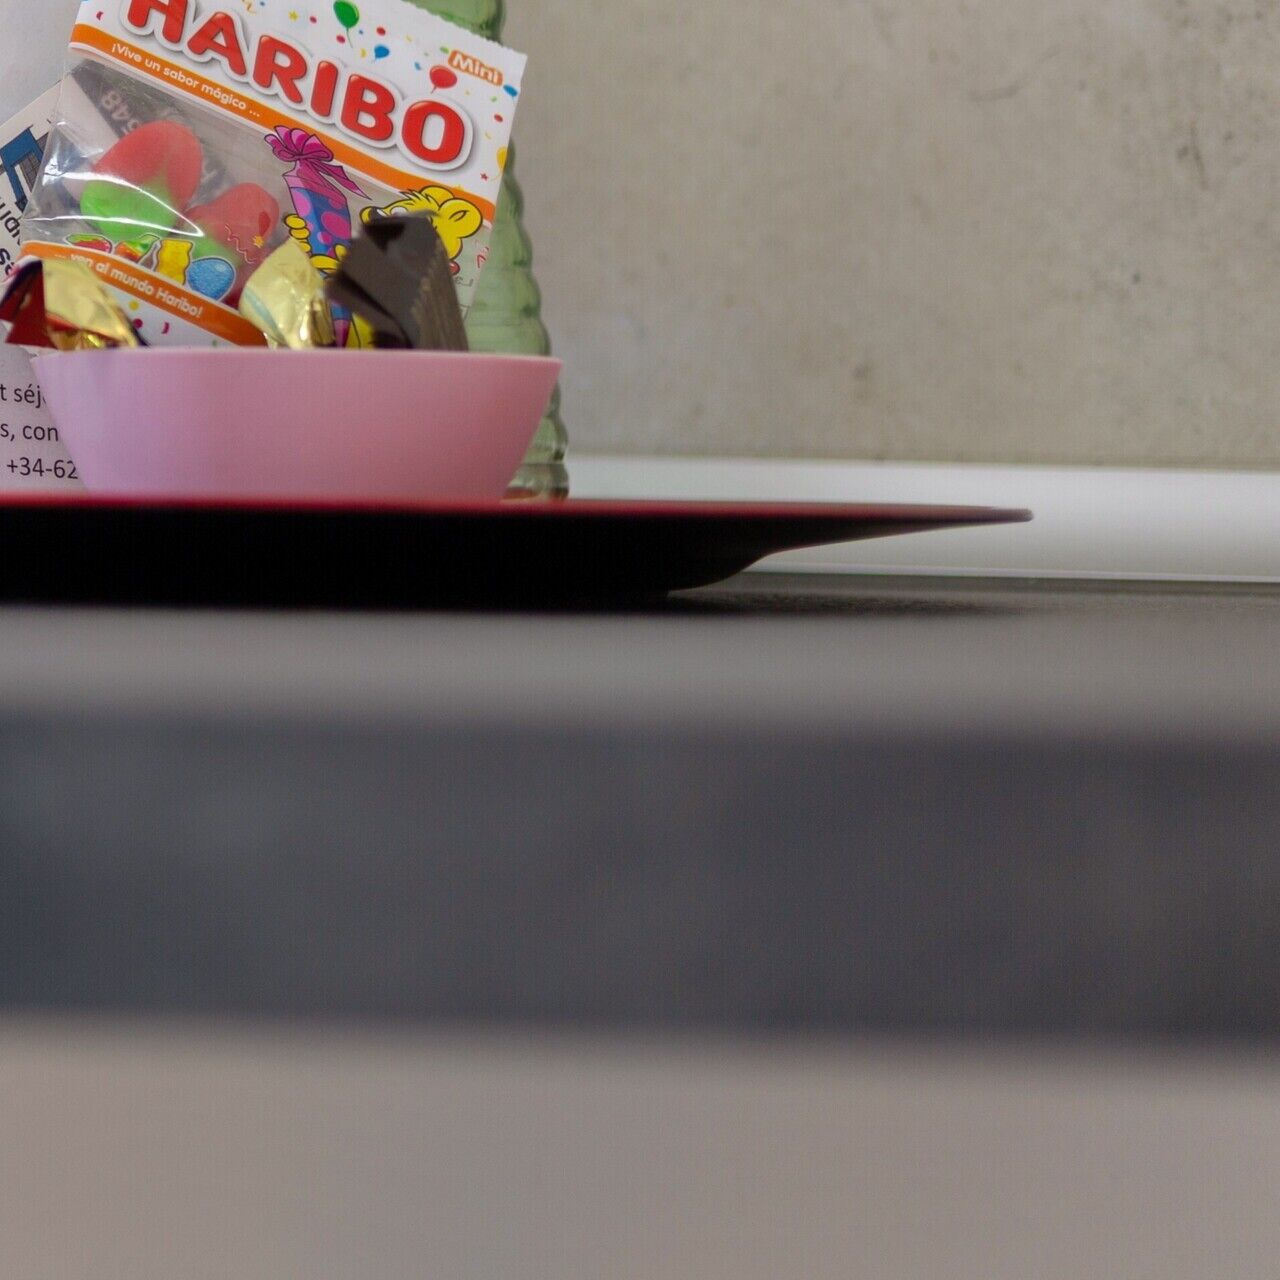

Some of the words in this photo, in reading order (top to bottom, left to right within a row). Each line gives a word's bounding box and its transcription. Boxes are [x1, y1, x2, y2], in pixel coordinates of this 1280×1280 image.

[111, 42, 142, 63] ¡Vive
[144, 57, 161, 72] un
[163, 66, 200, 89] sabor
[201, 83, 247, 110] mágico
[96, 263, 109, 276] al
[110, 268, 154, 295] mundo
[156, 287, 205, 319] Haribo!
[14, 383, 46, 409] séj
